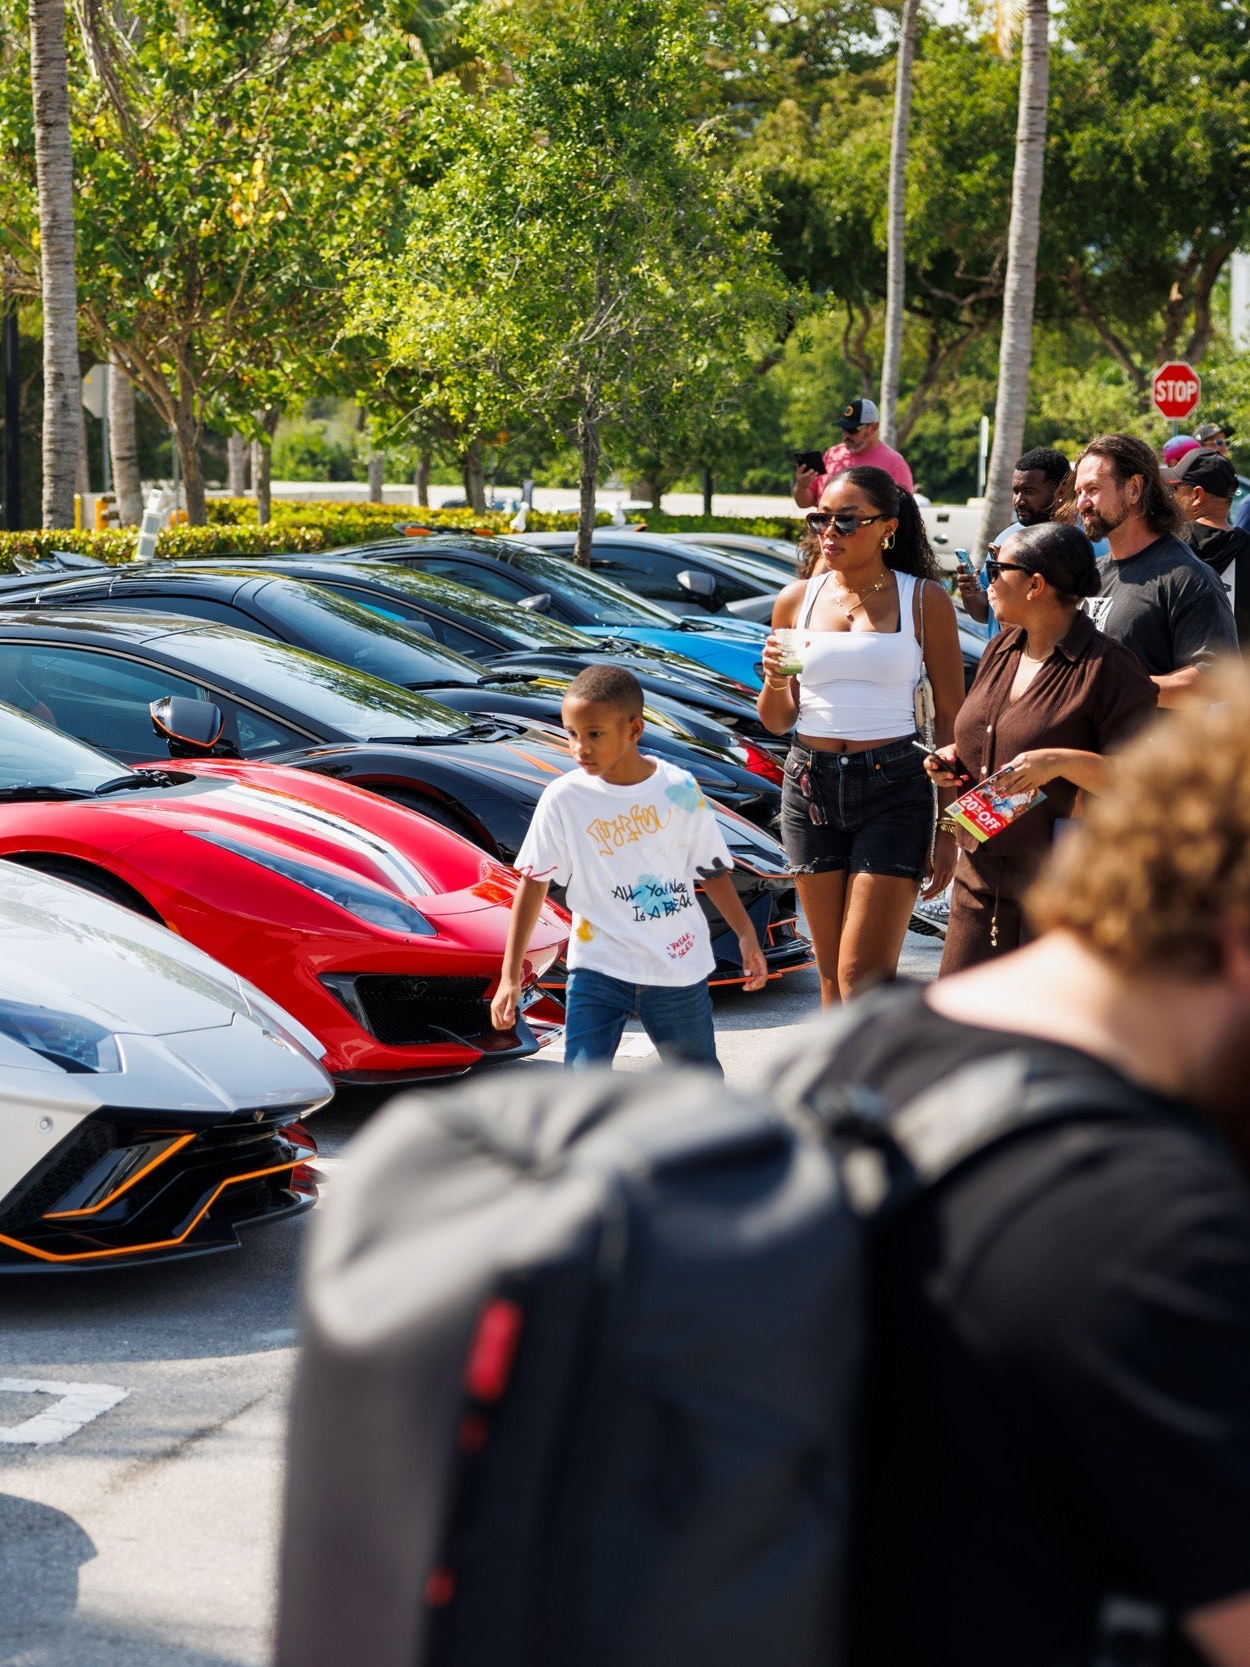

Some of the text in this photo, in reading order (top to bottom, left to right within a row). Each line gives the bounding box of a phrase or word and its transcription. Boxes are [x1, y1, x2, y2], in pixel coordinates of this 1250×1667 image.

[1156, 380, 1198, 403] STOP
[960, 795, 985, 812] 20%
[978, 811, 1002, 830] OFF
[611, 884, 642, 902] ALL
[647, 905, 661, 920] A
